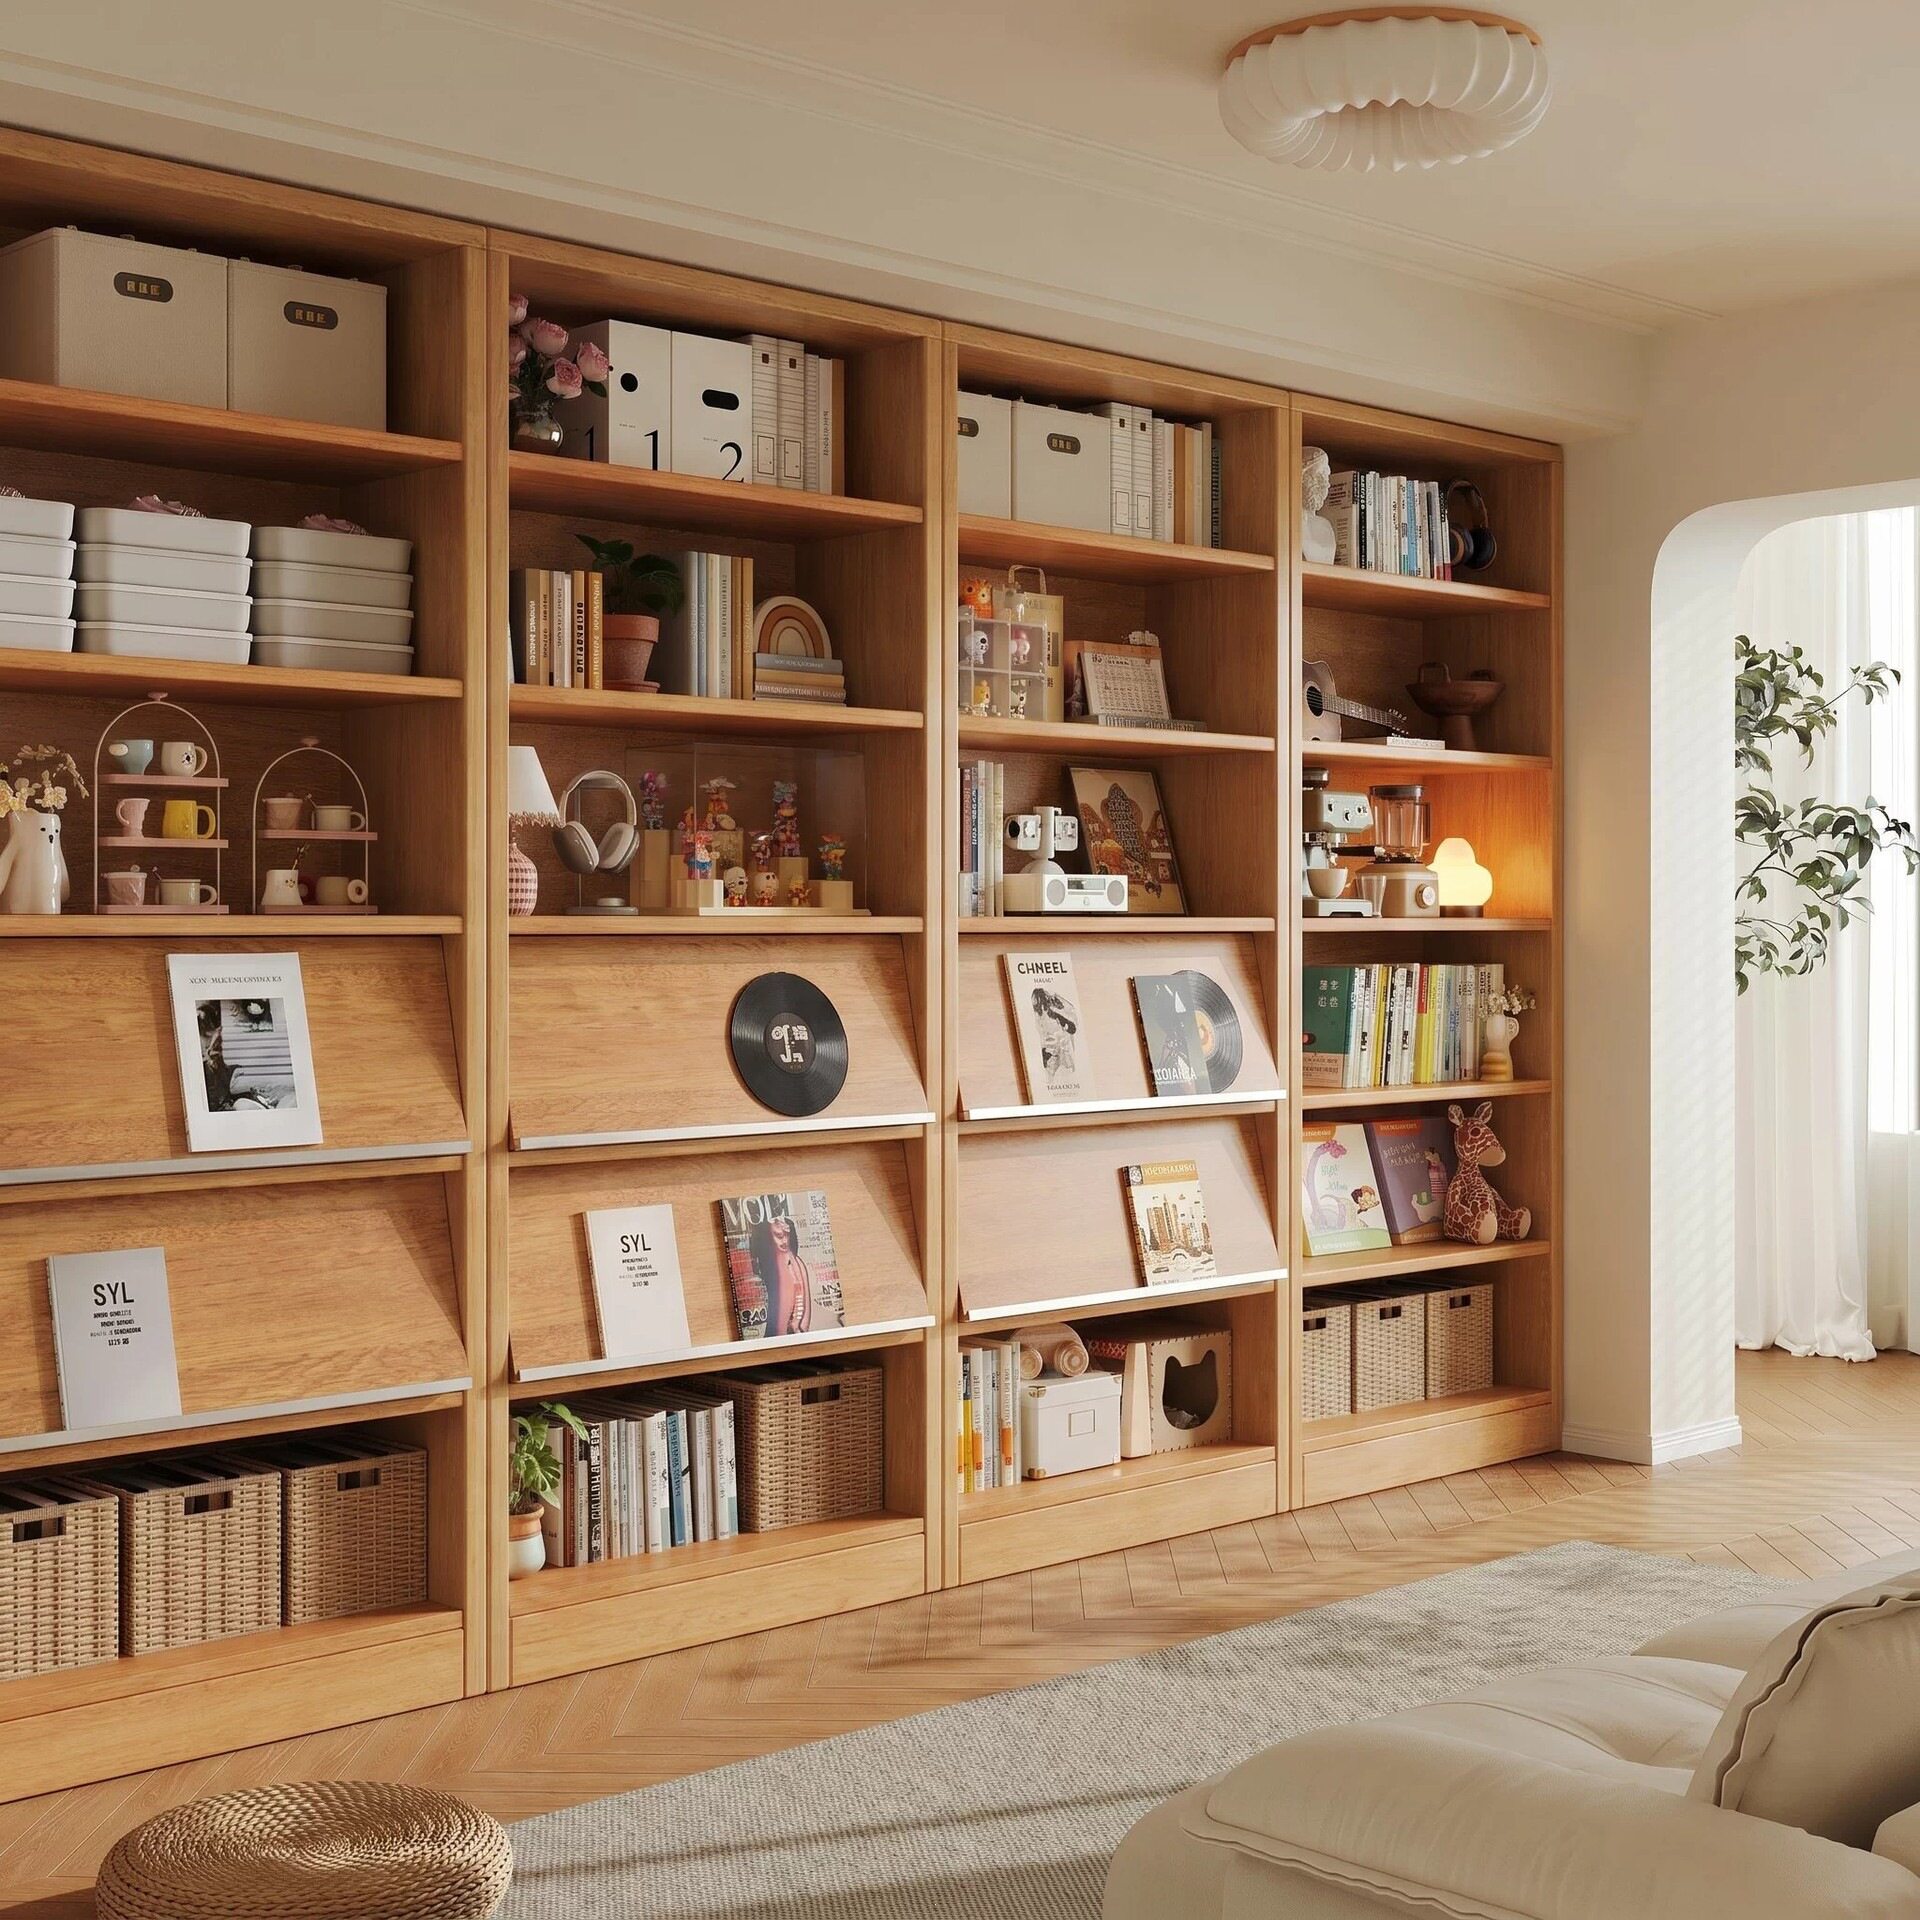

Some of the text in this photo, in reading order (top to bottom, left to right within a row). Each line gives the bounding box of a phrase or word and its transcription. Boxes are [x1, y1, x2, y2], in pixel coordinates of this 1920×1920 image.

[644, 429, 659, 471] 1
[720, 441, 744, 483] 2
[1017, 961, 1068, 975] CHNEEL
[620, 1233, 652, 1254] SYL
[93, 1281, 135, 1307] SYL
